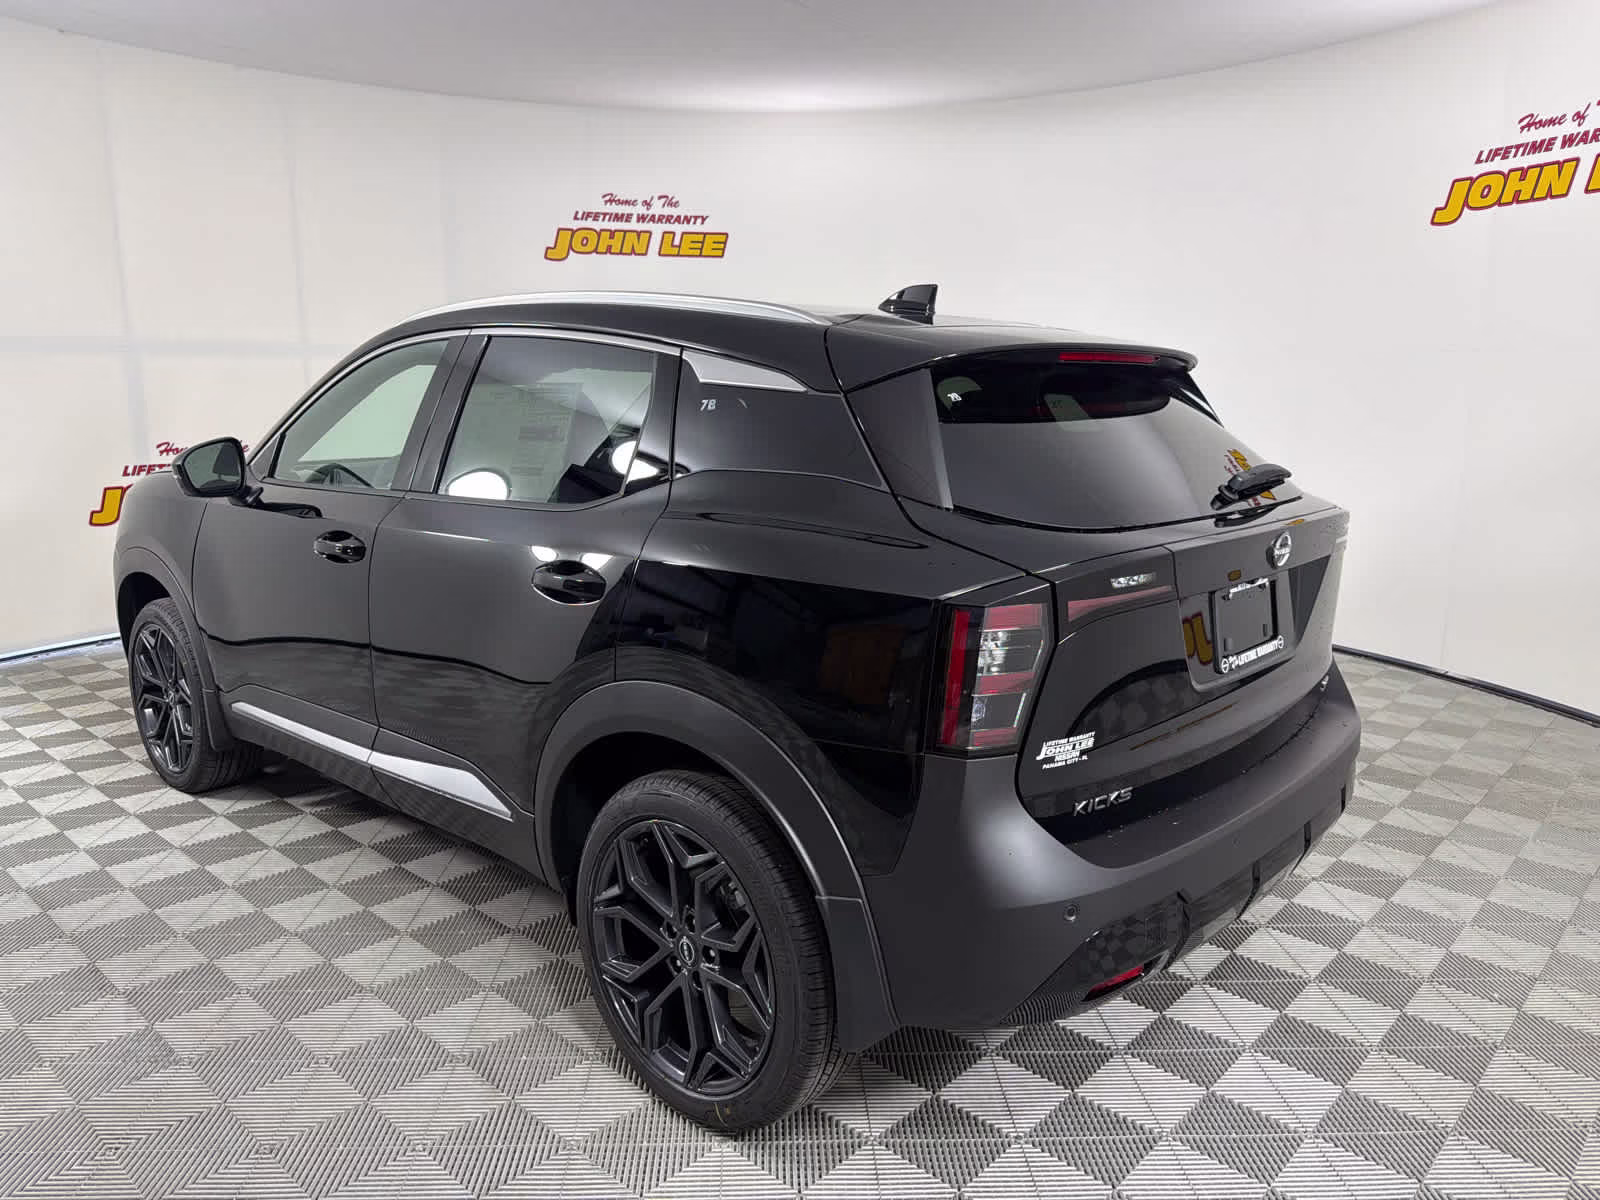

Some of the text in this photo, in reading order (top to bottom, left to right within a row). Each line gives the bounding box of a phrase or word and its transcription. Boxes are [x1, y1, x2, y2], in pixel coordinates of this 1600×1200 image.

[1518, 102, 1592, 133] Home of
[1474, 136, 1558, 165] LIFETIME
[601, 193, 680, 210] Home of The
[1430, 156, 1581, 226] JOHN
[573, 211, 709, 225] LIFETIME WARRANTY
[544, 227, 729, 261] JOHN LEE
[1036, 738, 1095, 760] JOHN LEE
[1073, 787, 1133, 817] KICKS
